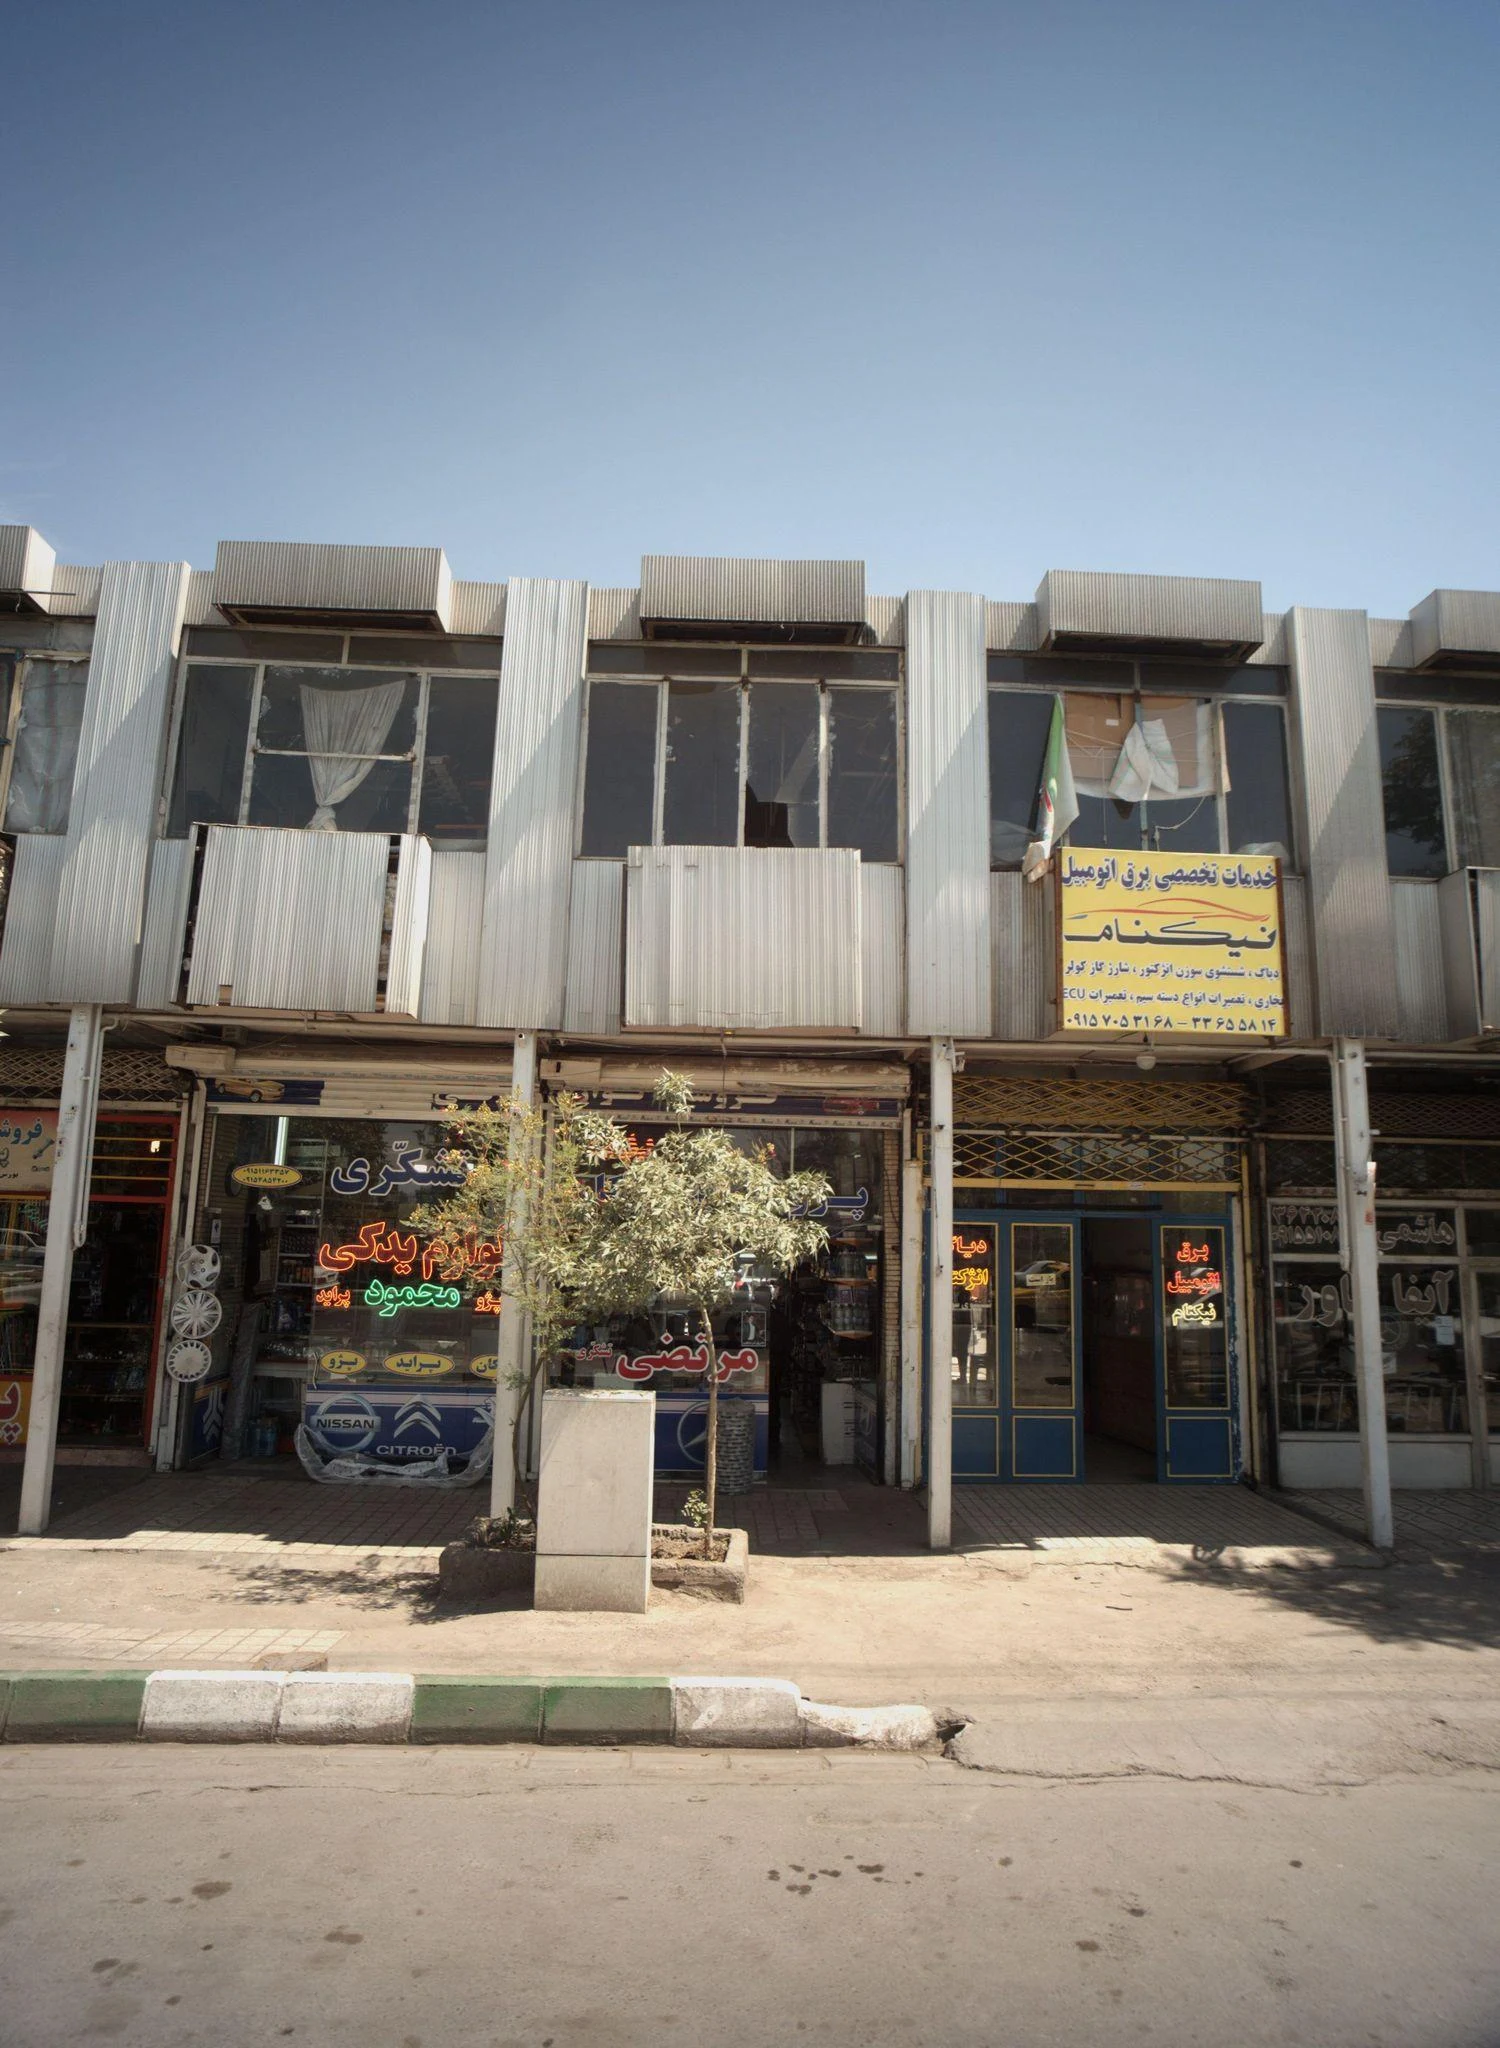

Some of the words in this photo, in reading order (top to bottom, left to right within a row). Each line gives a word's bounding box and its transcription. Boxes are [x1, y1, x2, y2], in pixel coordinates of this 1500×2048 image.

[1062, 856, 1118, 887] اتومبیل
[1121, 861, 1151, 888] برق
[1155, 863, 1219, 891] تخصصی
[1222, 863, 1278, 888] خدمات
[1064, 960, 1087, 975] کولر
[1139, 963, 1173, 978] انژکتور
[1176, 967, 1202, 978] سوزن
[1205, 965, 1245, 979] شستشوی
[1063, 987, 1086, 999] ECU
[1089, 989, 1127, 1004] تعمیرات
[1136, 993, 1154, 1004] سیم
[1157, 993, 1178, 1003] دسته
[1182, 991, 1206, 1006] انواع
[1209, 992, 1245, 1007] تعمیرات
[1376, 1214, 1455, 1251] هاشمی
[319, 1221, 418, 1275] یدکی
[952, 1235, 987, 1258] دیا
[1176, 1241, 1209, 1262] برق
[1167, 1270, 1220, 1295] اتومبیل
[316, 1285, 351, 1308] پراید
[364, 1279, 461, 1316] محمود
[1295, 1272, 1354, 1328] اور
[329, 1354, 359, 1370] پژو
[396, 1355, 442, 1373] پراید
[616, 1332, 760, 1383] مرتضی
[316, 1418, 375, 1429] NISSAN
